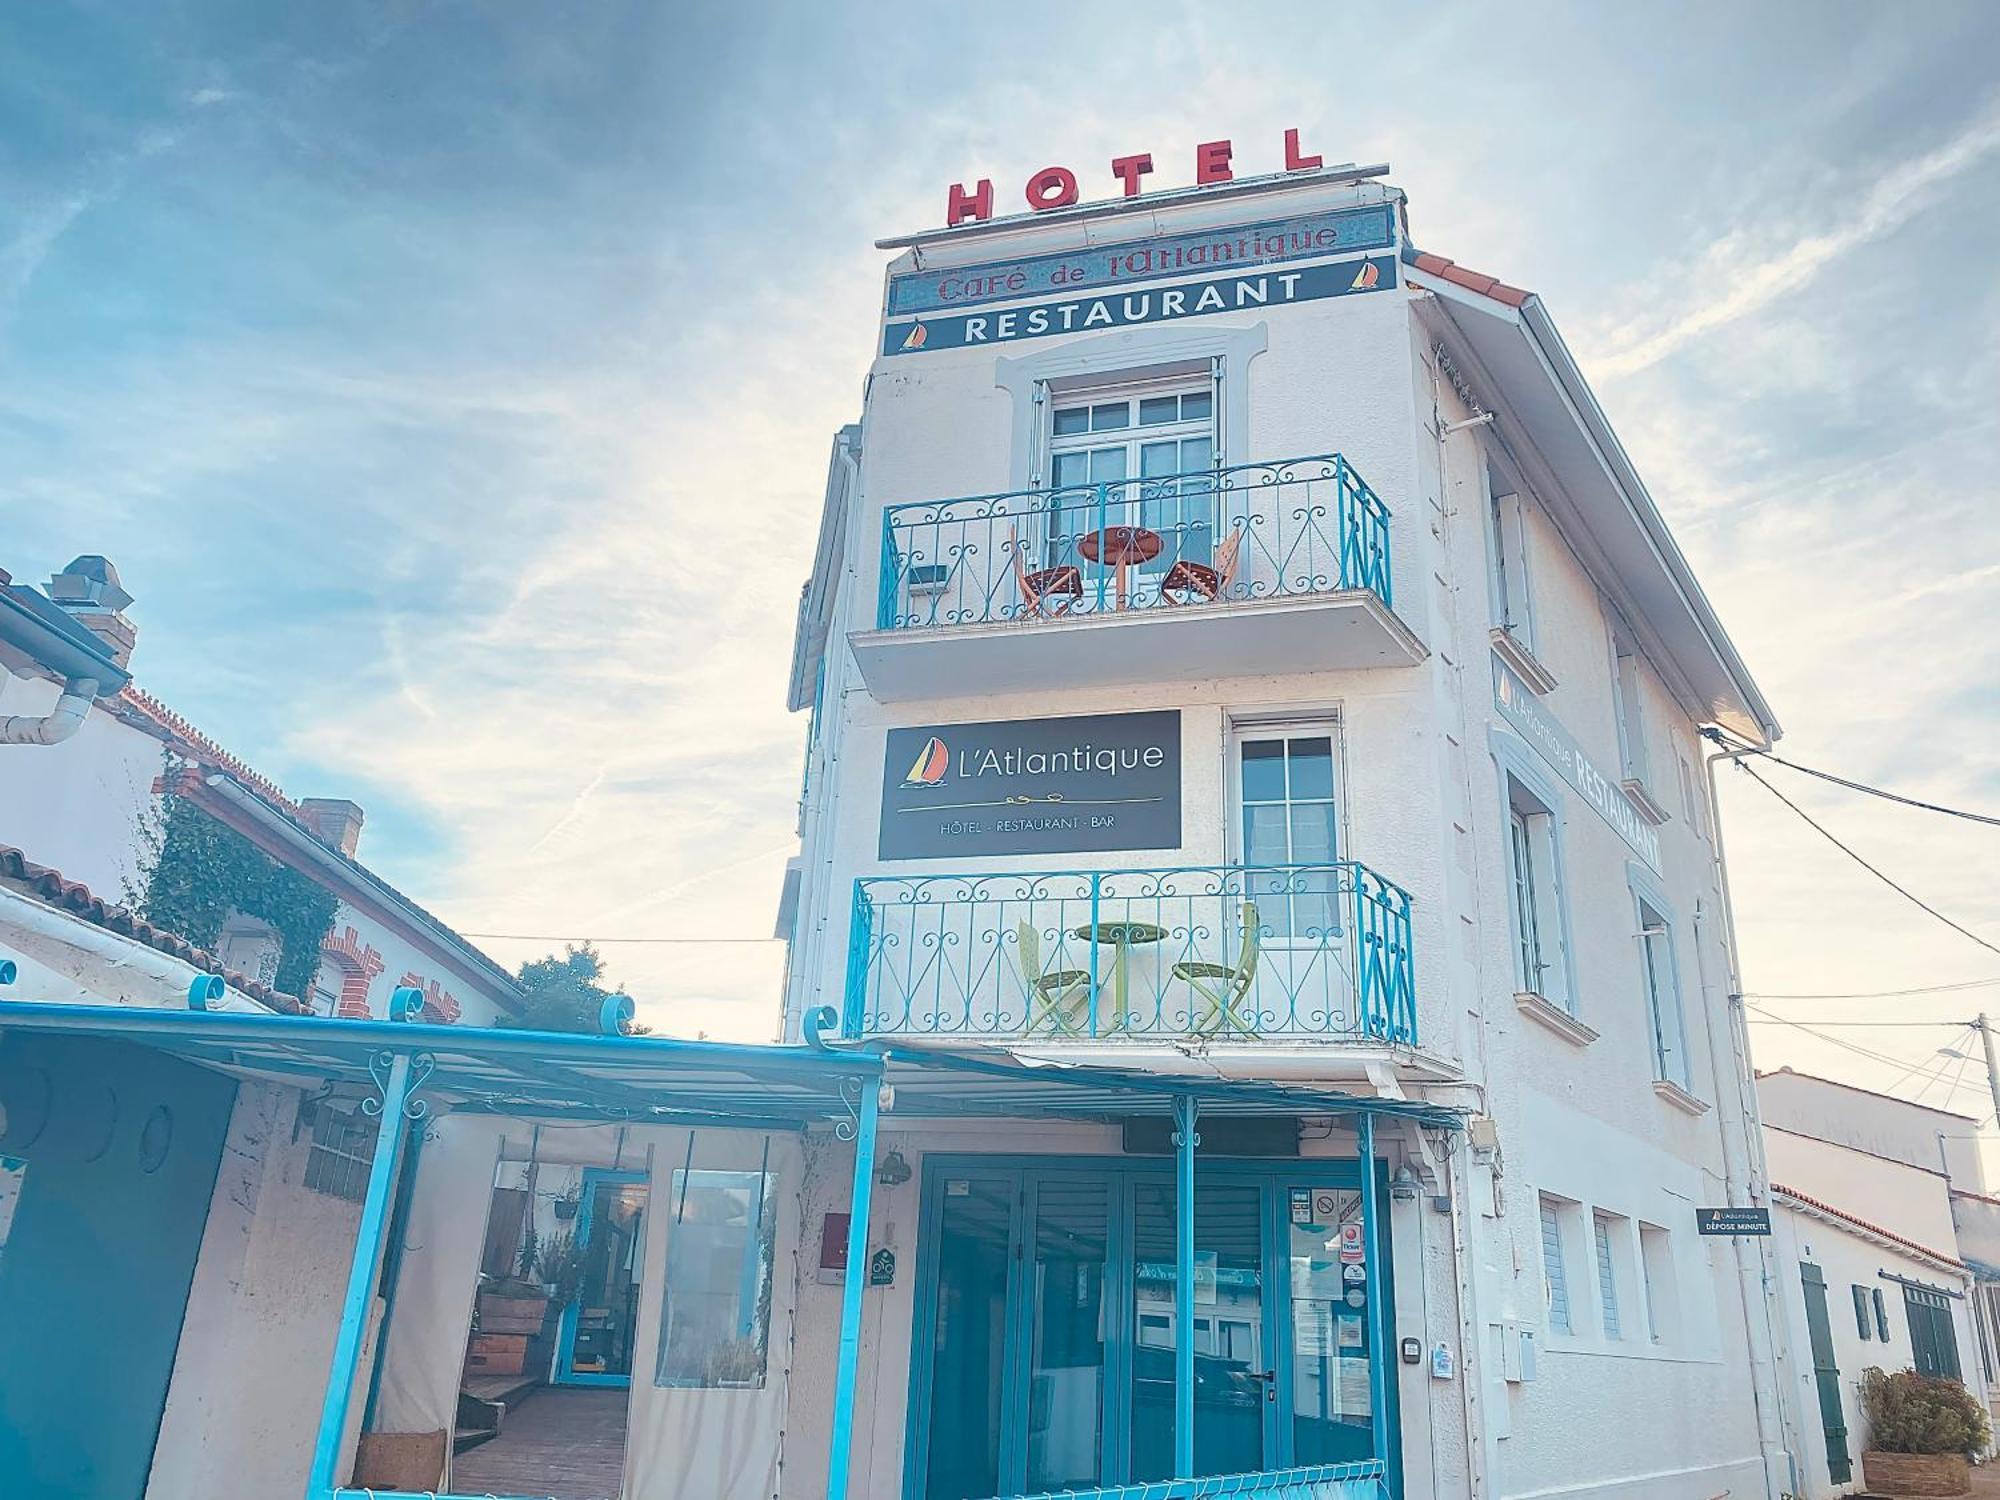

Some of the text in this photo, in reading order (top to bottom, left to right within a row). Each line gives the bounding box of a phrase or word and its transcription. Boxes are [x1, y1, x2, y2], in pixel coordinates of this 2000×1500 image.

[948, 128, 1323, 227] HOTEL
[1050, 264, 1084, 285] de
[964, 274, 1303, 343] RESTAURANT
[959, 744, 1164, 778] L'Atlantique
[940, 815, 1115, 836] HÔTEL RESTAURANT BAR
[1575, 750, 1661, 867] RESTAURANT
[1737, 1222, 1767, 1231] MINUTE
